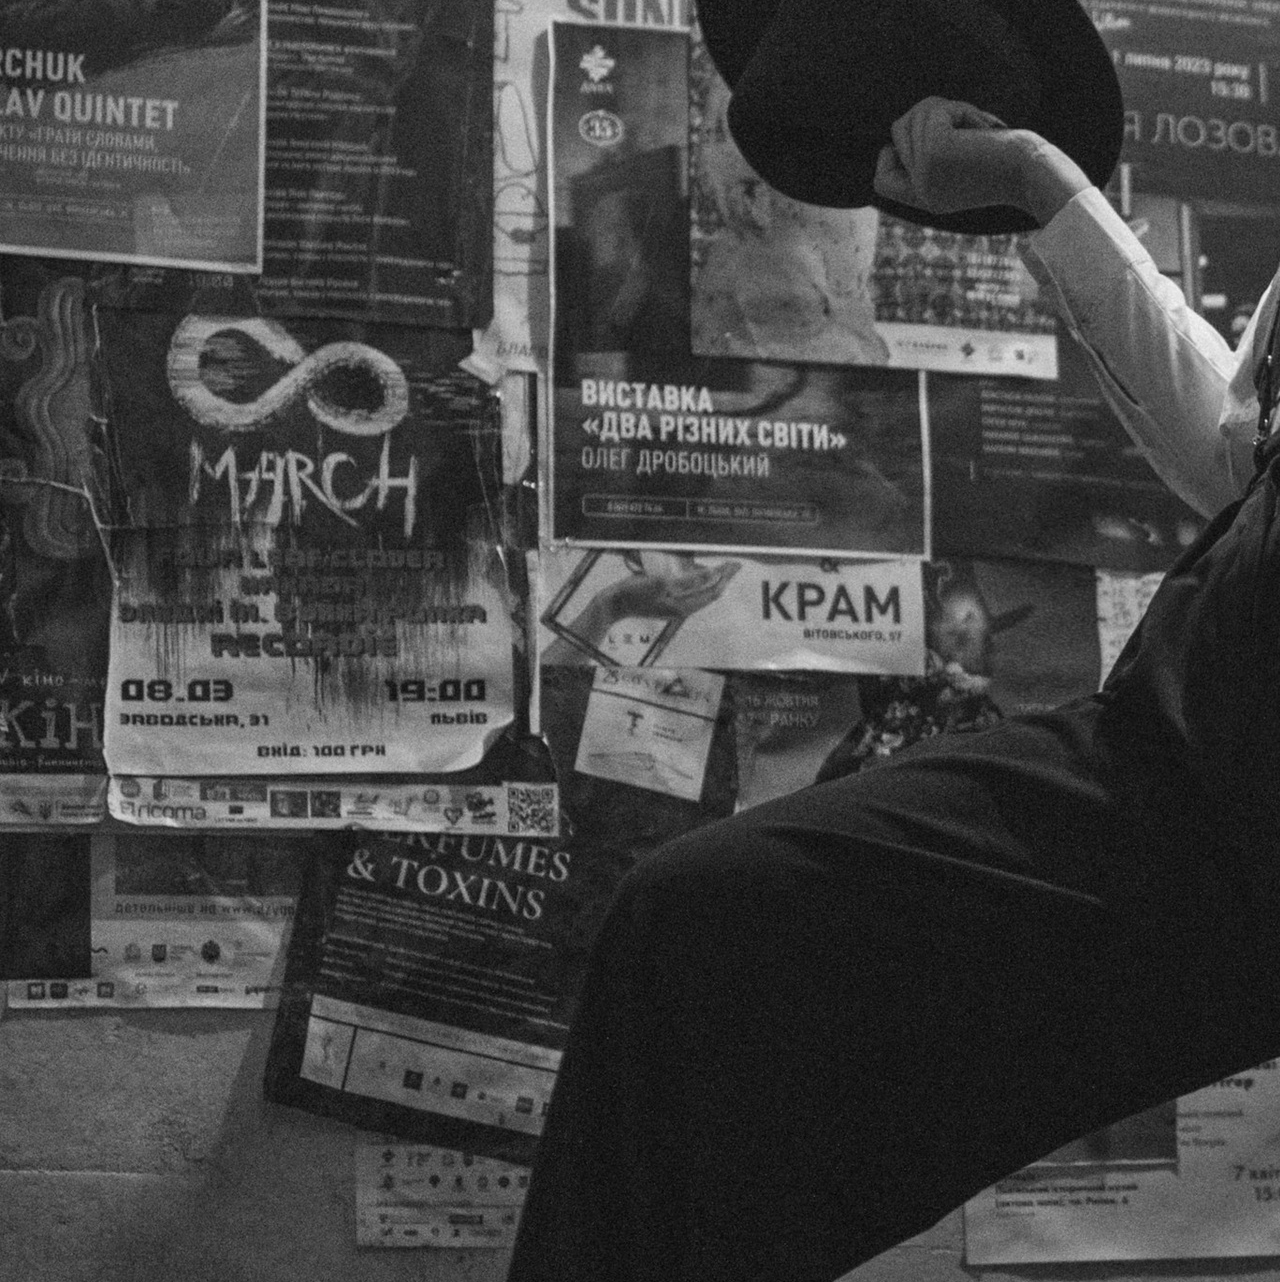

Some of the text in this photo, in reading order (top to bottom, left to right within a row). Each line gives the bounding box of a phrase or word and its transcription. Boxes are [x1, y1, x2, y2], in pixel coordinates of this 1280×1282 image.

[0, 48, 86, 84] CHUK
[53, 90, 180, 132] QUINTET
[580, 378, 714, 415] ВИСТАВКА
[581, 410, 848, 452] «ДВА РІЗНИХ СВІТИ»
[580, 445, 772, 480] ОЛЕГ ДРОБОЦЬКИЙ
[187, 434, 420, 539] MARCH
[761, 579, 903, 626] КРАМ
[120, 679, 487, 703] 08.03 19:00
[346, 848, 546, 923] & TOXINS
